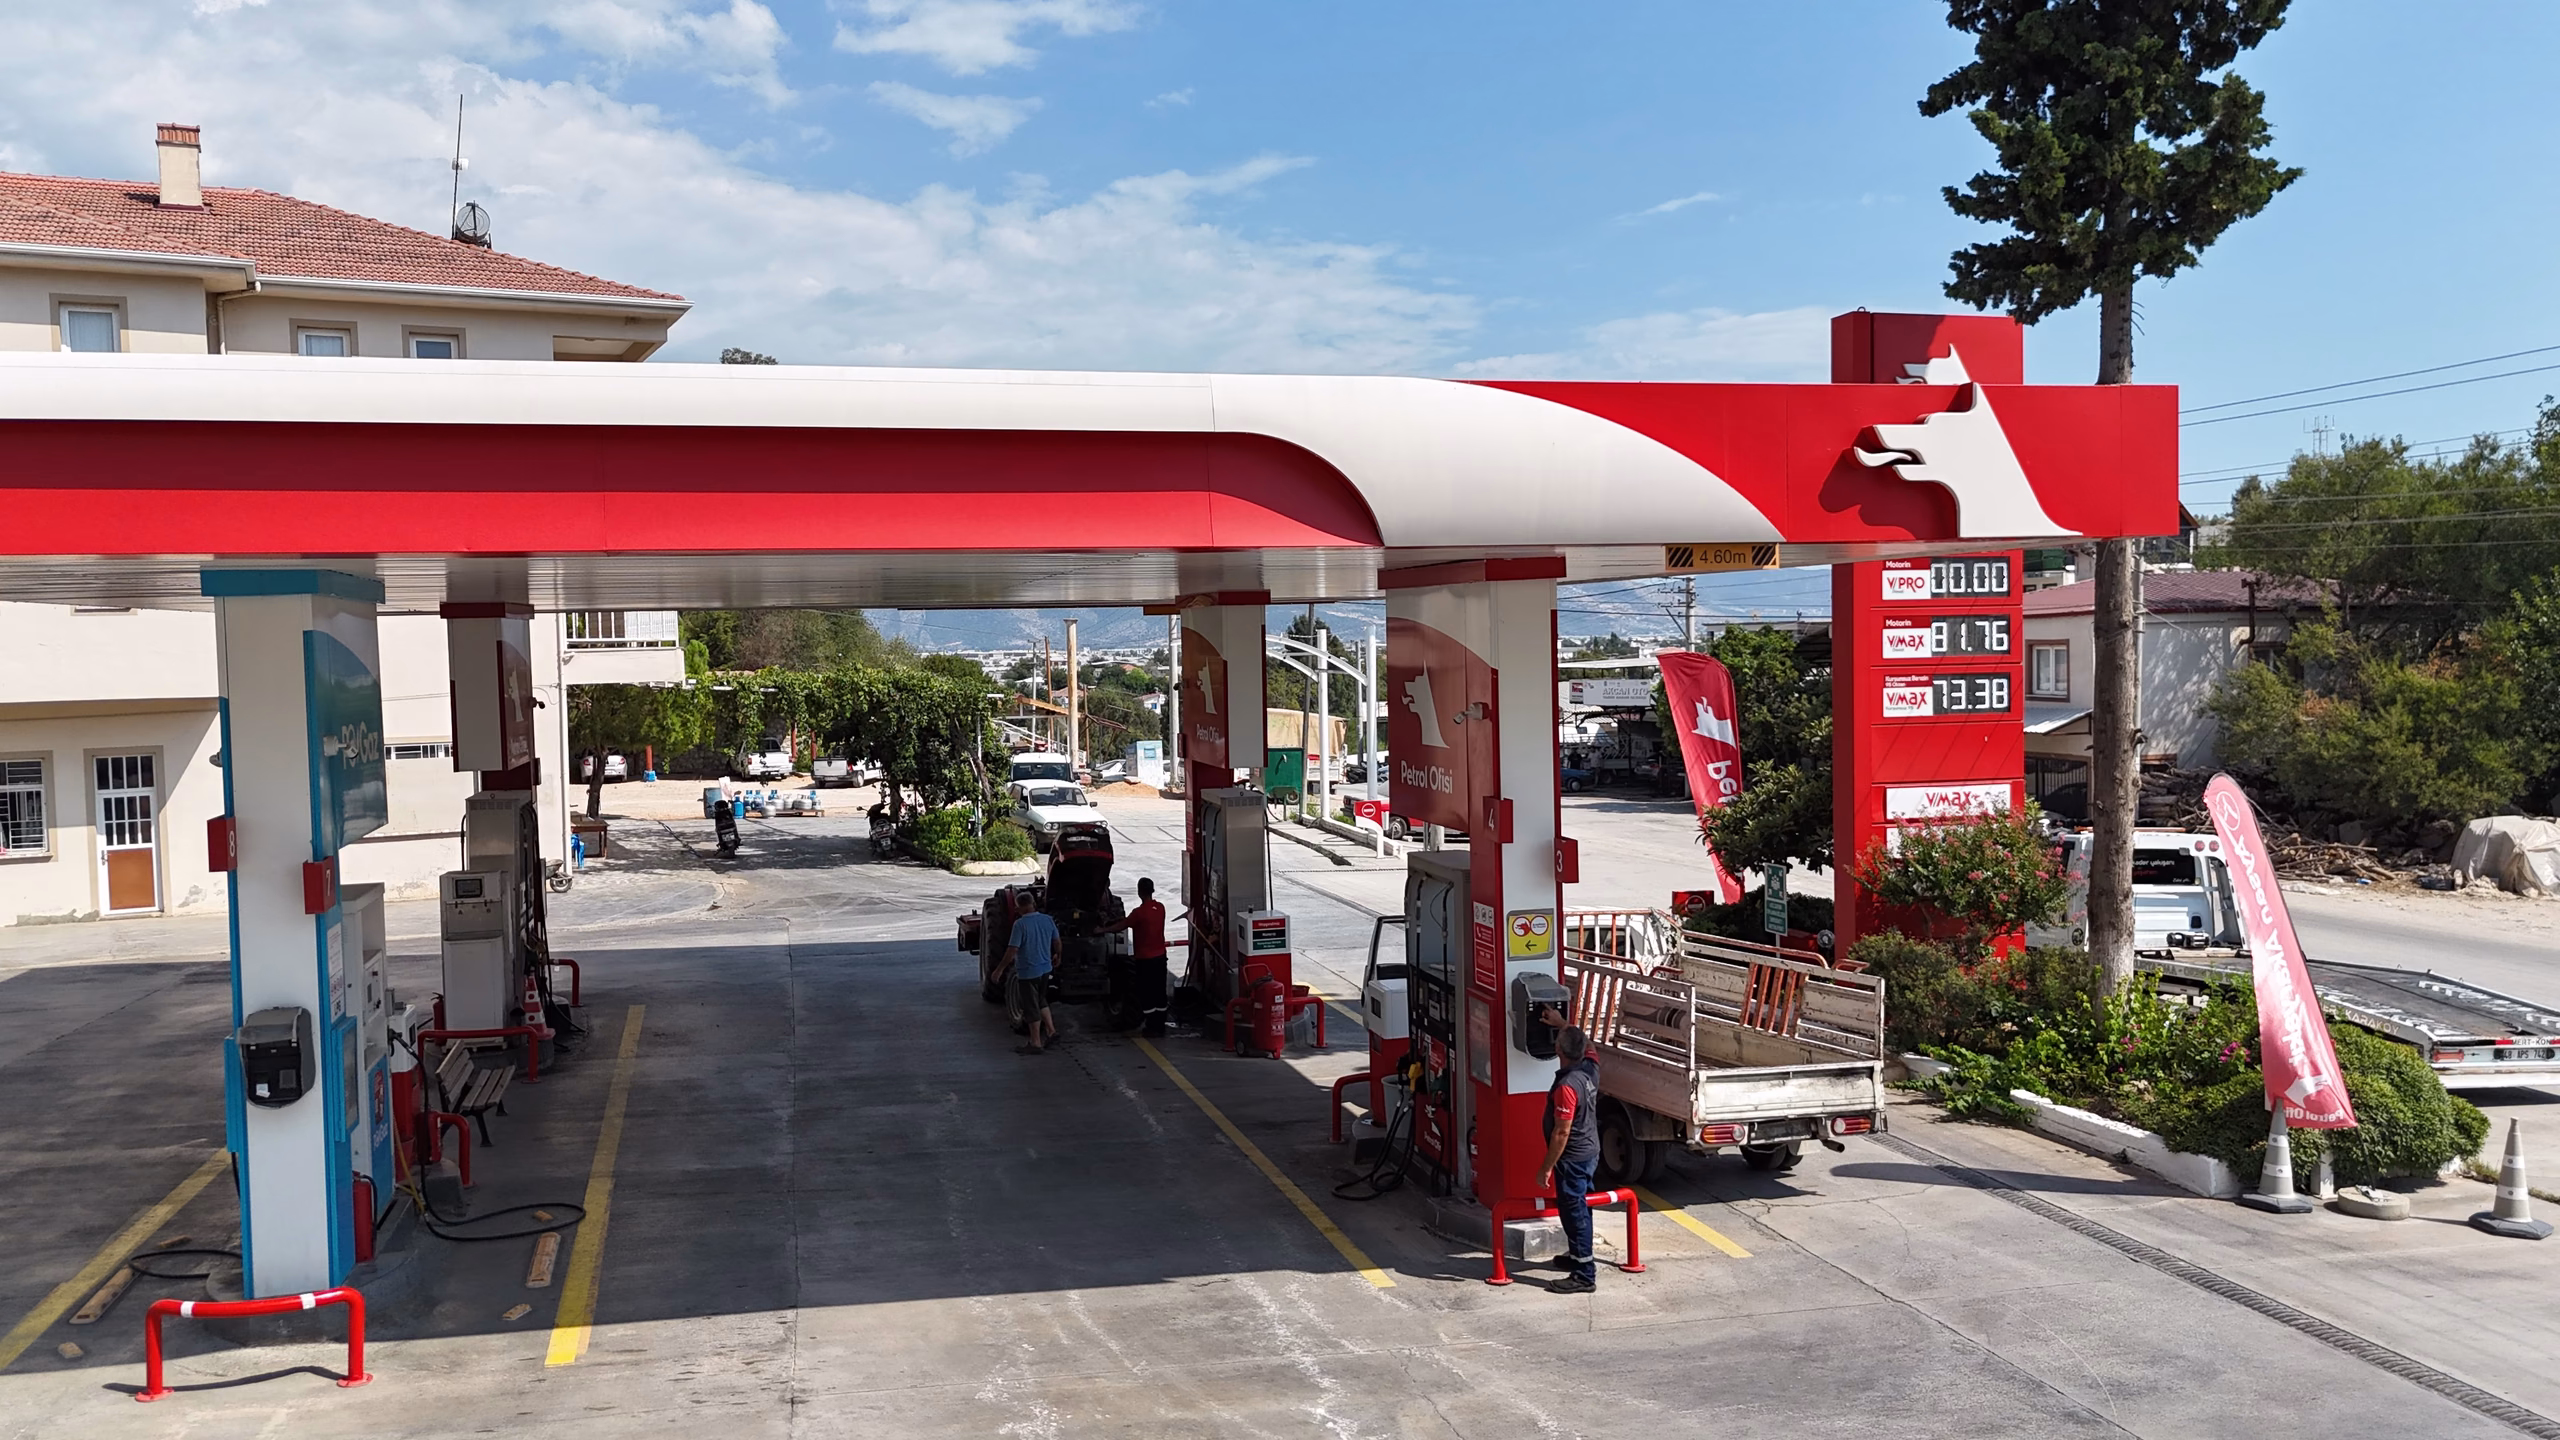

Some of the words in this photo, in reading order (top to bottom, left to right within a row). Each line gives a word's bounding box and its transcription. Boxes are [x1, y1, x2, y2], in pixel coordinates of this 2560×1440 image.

[1699, 549, 1746, 564] 4.60m
[1885, 560, 1912, 569] Motorin
[1885, 619, 1912, 627] Motorin
[1401, 759, 1428, 789] Petrol
[1430, 765, 1453, 795] Ofisi
[1487, 808, 1495, 831] 4
[228, 830, 236, 857] 8
[1556, 850, 1563, 873] 3
[325, 868, 332, 894] 7
